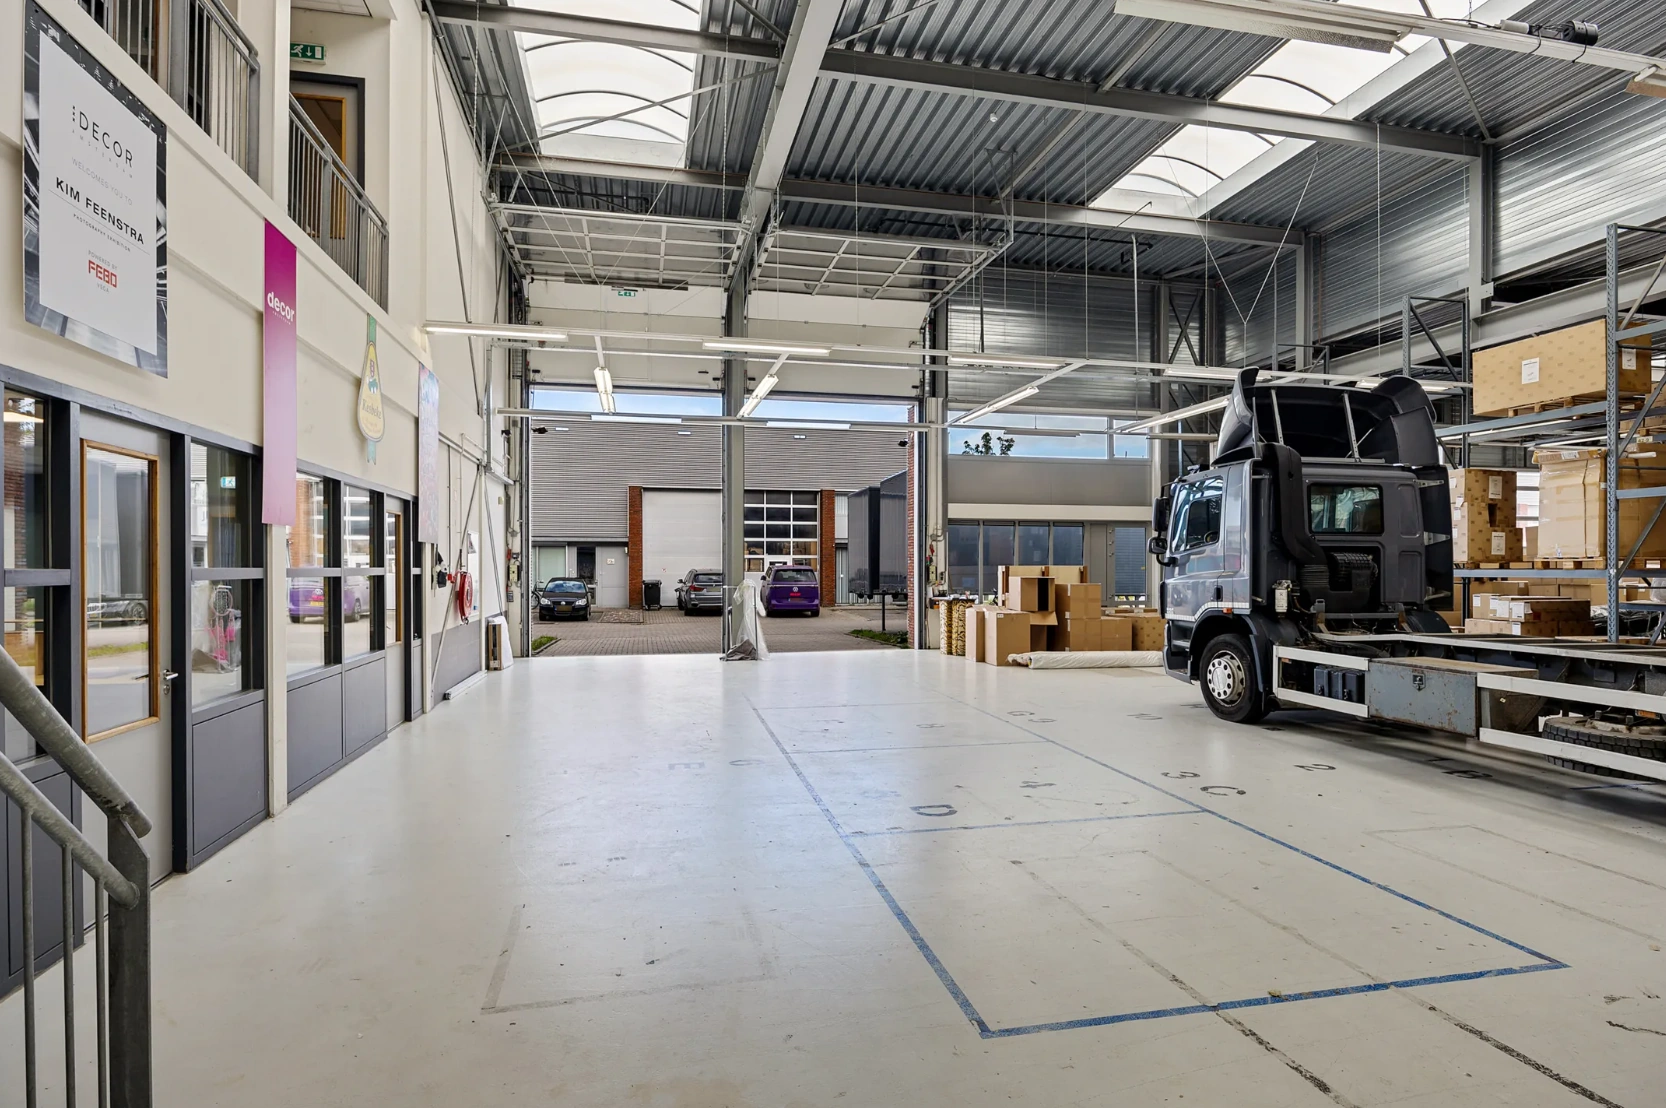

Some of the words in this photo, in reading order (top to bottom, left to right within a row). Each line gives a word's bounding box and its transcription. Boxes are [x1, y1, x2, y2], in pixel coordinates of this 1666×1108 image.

[79, 111, 133, 168] DECOR
[72, 157, 109, 189] WELCOMES
[56, 177, 80, 202] KIM
[86, 197, 144, 244] FEENSTRA
[88, 250, 111, 267] POWERED
[88, 260, 118, 288] FEBO
[267, 291, 295, 322] decor
[909, 804, 958, 817] D
